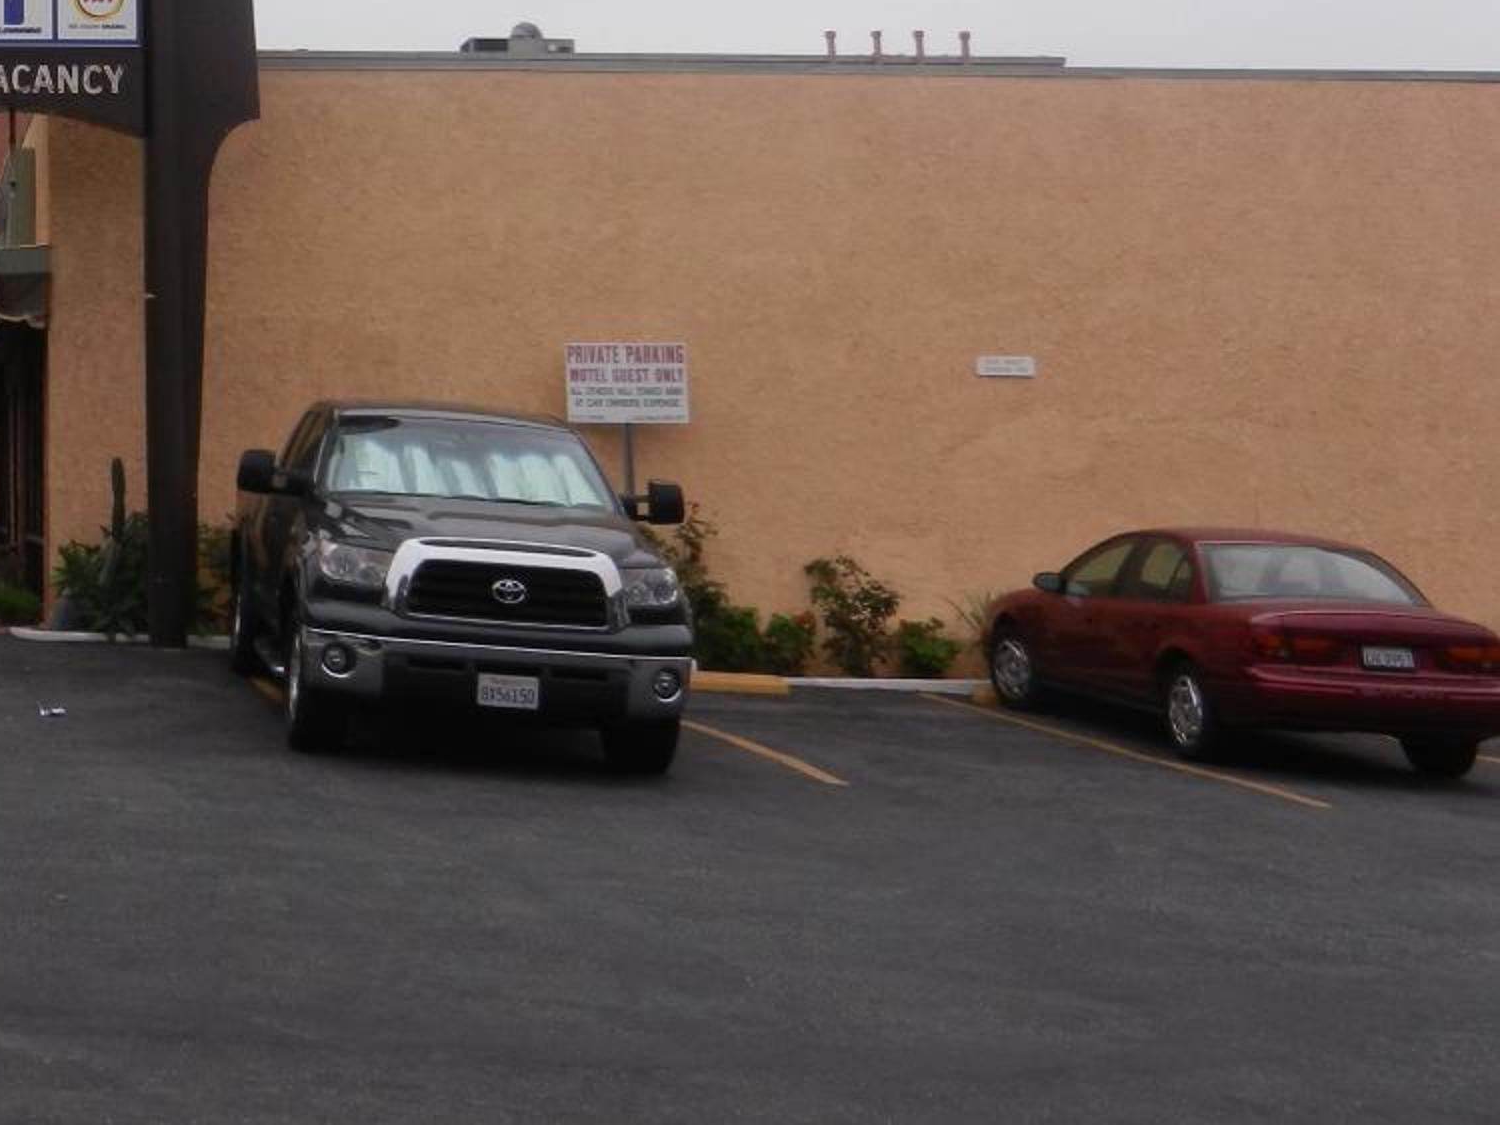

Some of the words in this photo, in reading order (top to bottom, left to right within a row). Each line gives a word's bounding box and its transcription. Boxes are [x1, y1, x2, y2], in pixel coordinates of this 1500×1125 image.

[566, 345, 621, 364] PRIVATE
[626, 345, 684, 364] PARKING
[570, 368, 607, 382] MOTEL
[611, 368, 649, 383] GUEST
[655, 368, 684, 383] ONLY
